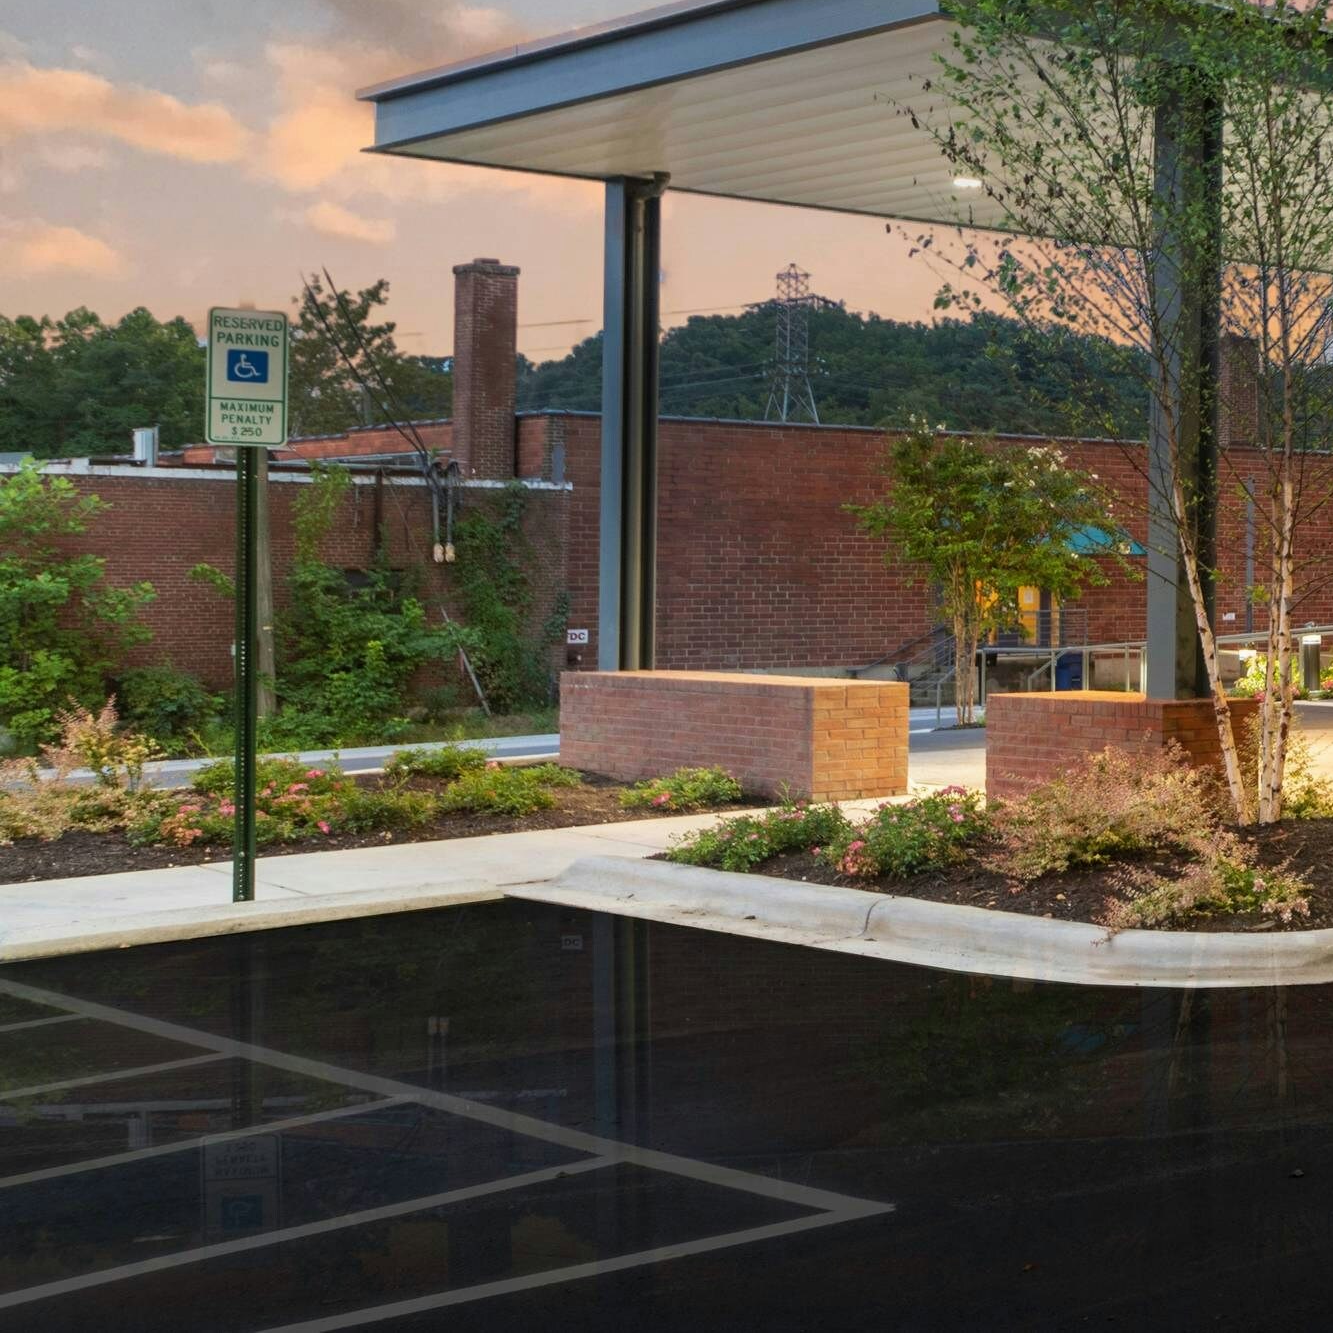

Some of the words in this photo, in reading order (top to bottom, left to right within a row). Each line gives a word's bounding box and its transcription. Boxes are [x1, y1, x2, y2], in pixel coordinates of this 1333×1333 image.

[214, 315, 283, 331] RESERVED
[216, 331, 280, 348] PARKING
[220, 401, 274, 414] MAXIMUM
[221, 414, 272, 425] PENALTY
[567, 632, 586, 641] DC
